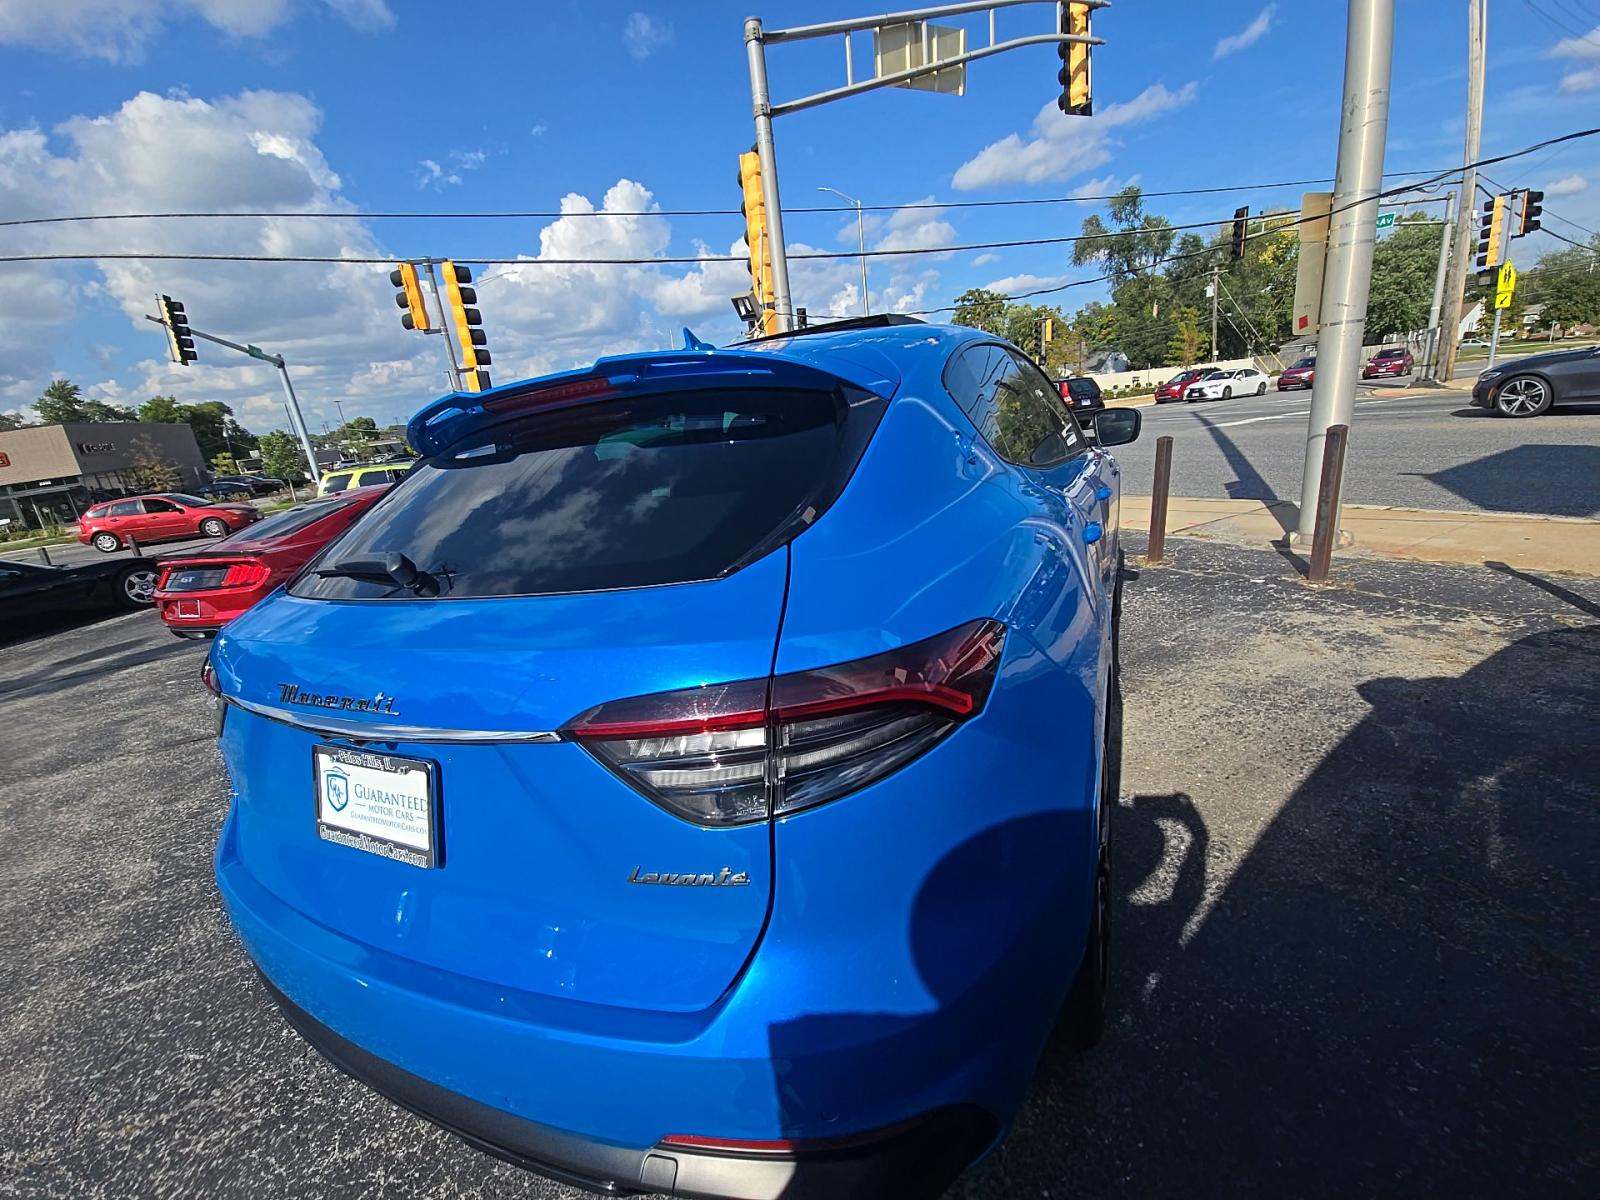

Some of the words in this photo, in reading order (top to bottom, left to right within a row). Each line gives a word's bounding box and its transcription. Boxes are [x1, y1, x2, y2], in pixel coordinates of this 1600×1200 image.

[278, 683, 401, 716] Maserati
[368, 803, 394, 818] MOTOR
[395, 809, 414, 822] CARS
[628, 864, 751, 887] Levante
